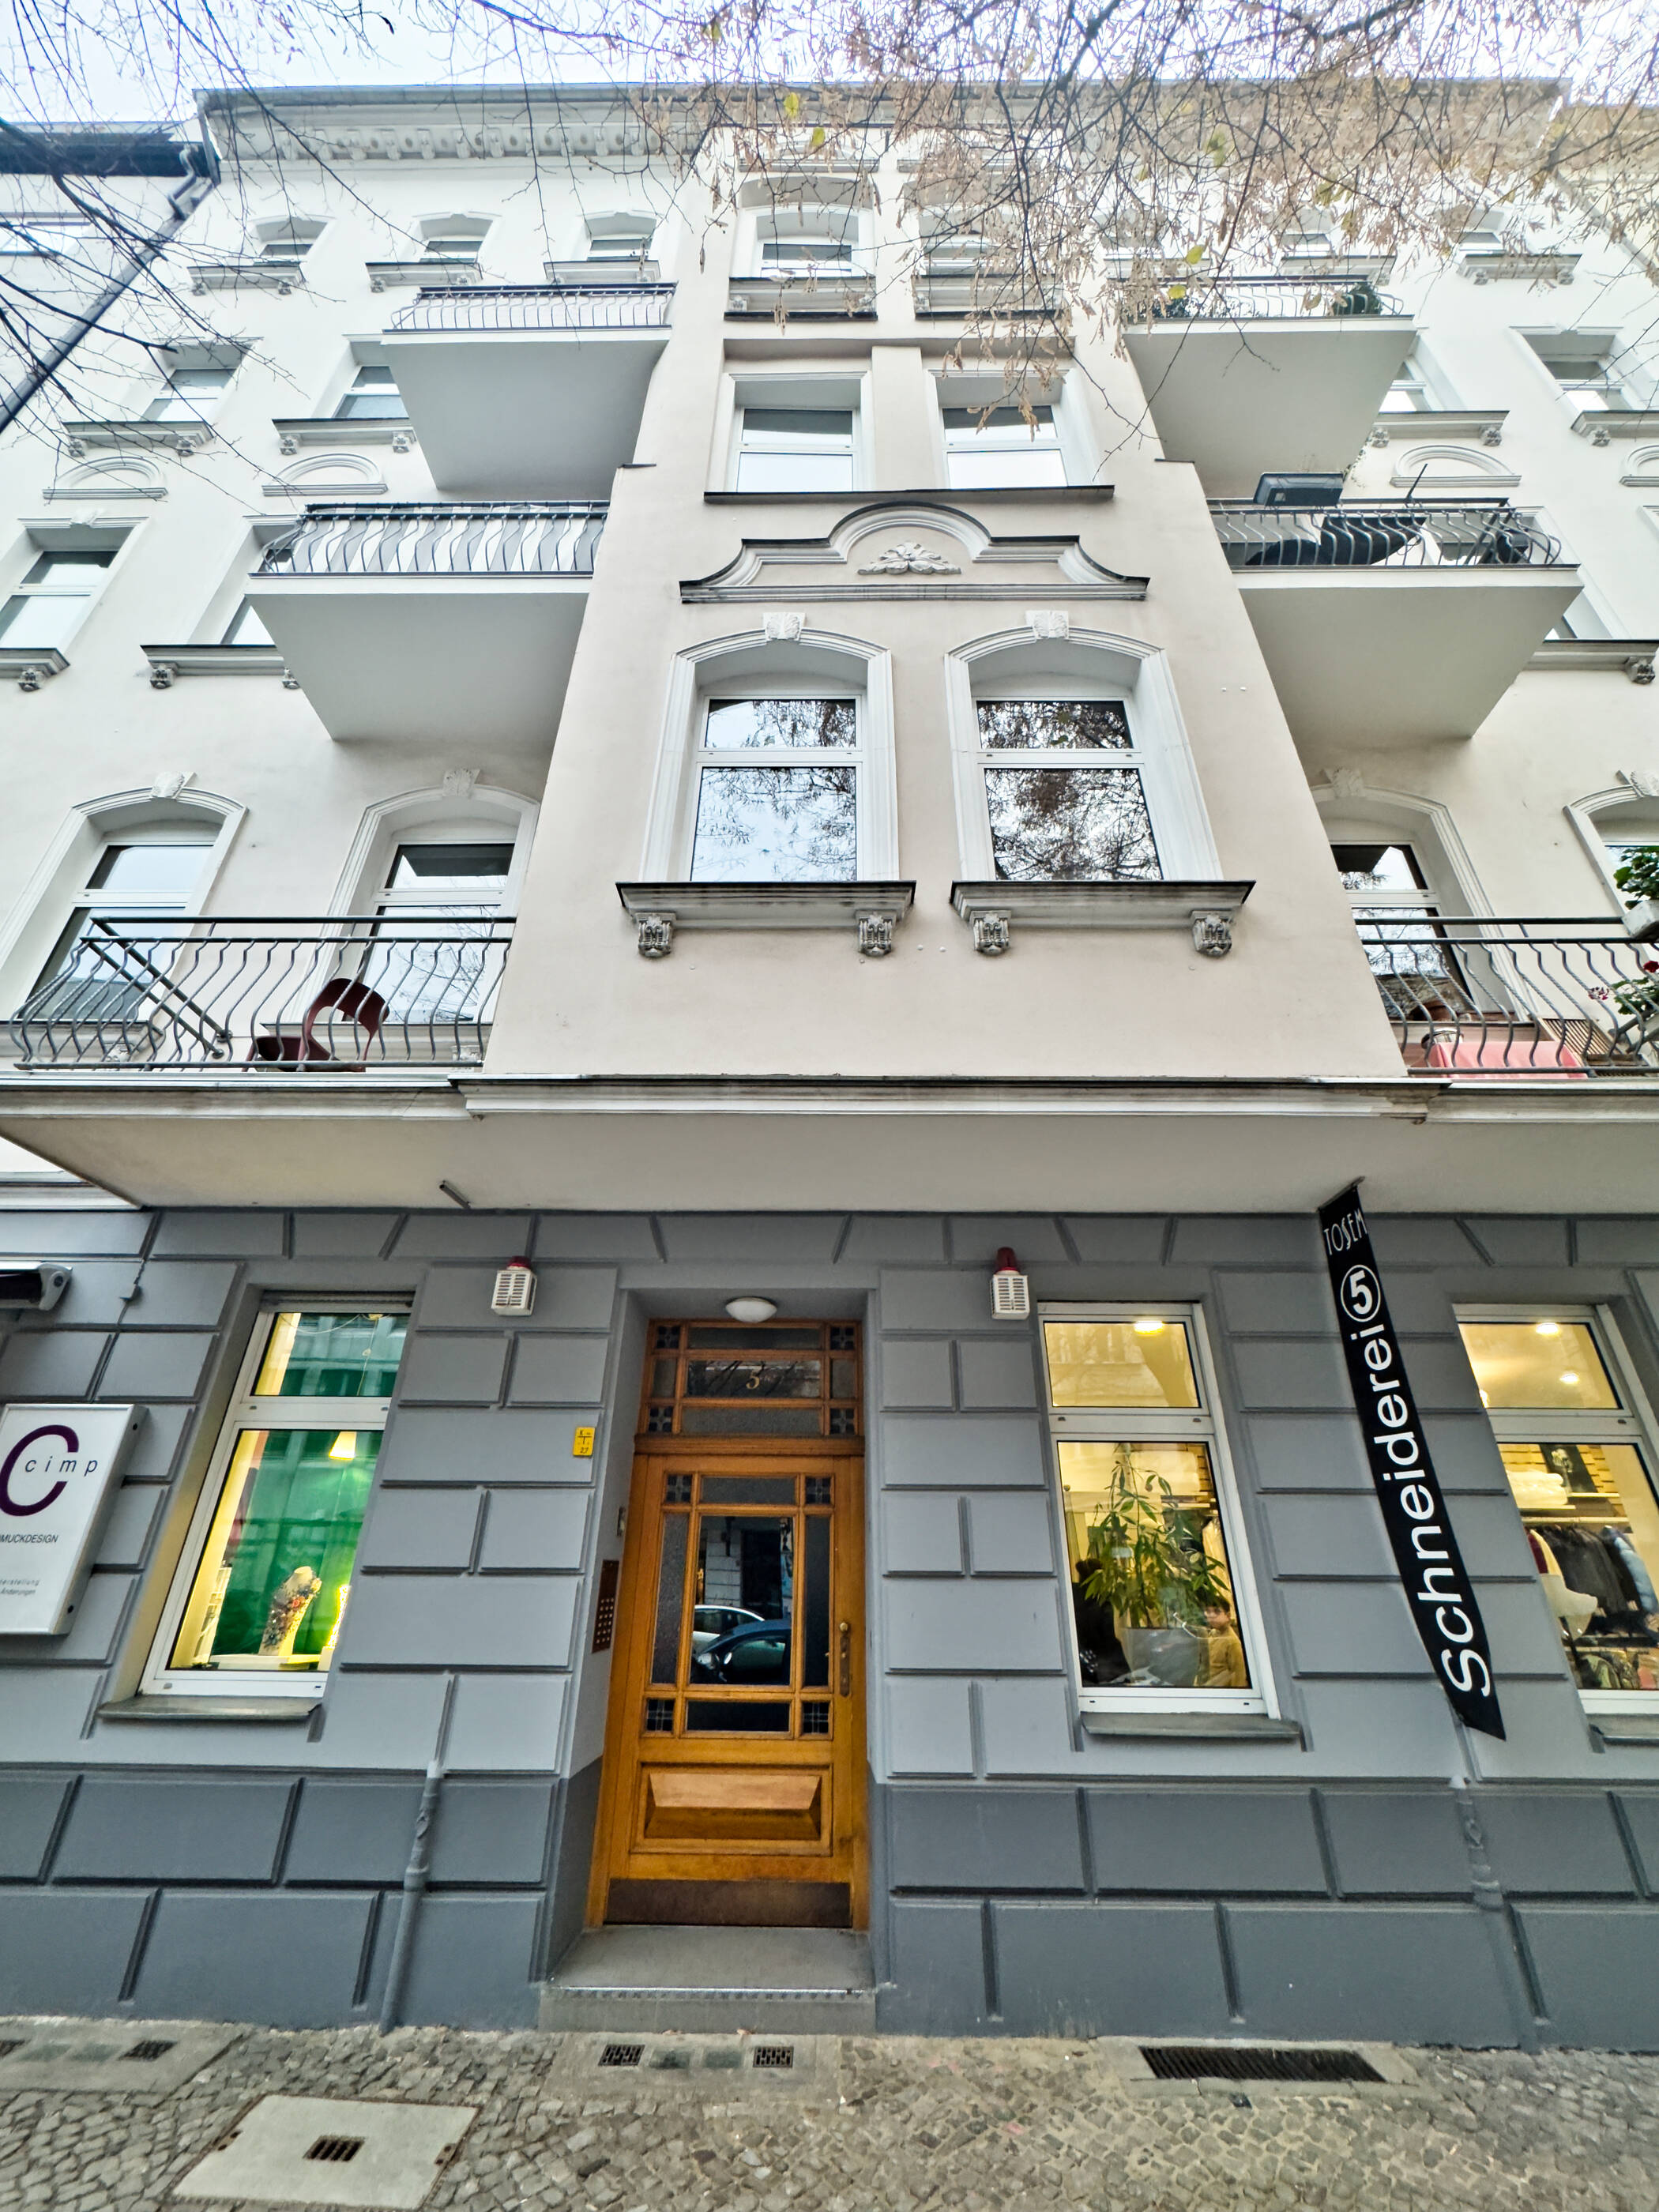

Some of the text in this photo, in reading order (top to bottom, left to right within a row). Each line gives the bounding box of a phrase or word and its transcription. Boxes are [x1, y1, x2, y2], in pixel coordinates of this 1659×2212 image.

[1349, 1270, 1372, 1315] 5
[746, 1368, 760, 1390] 5
[24, 1456, 98, 1477] cimp
[1351, 1324, 1491, 1698] Schneiderei
[0, 1534, 58, 1543] MUCKDESIGN
